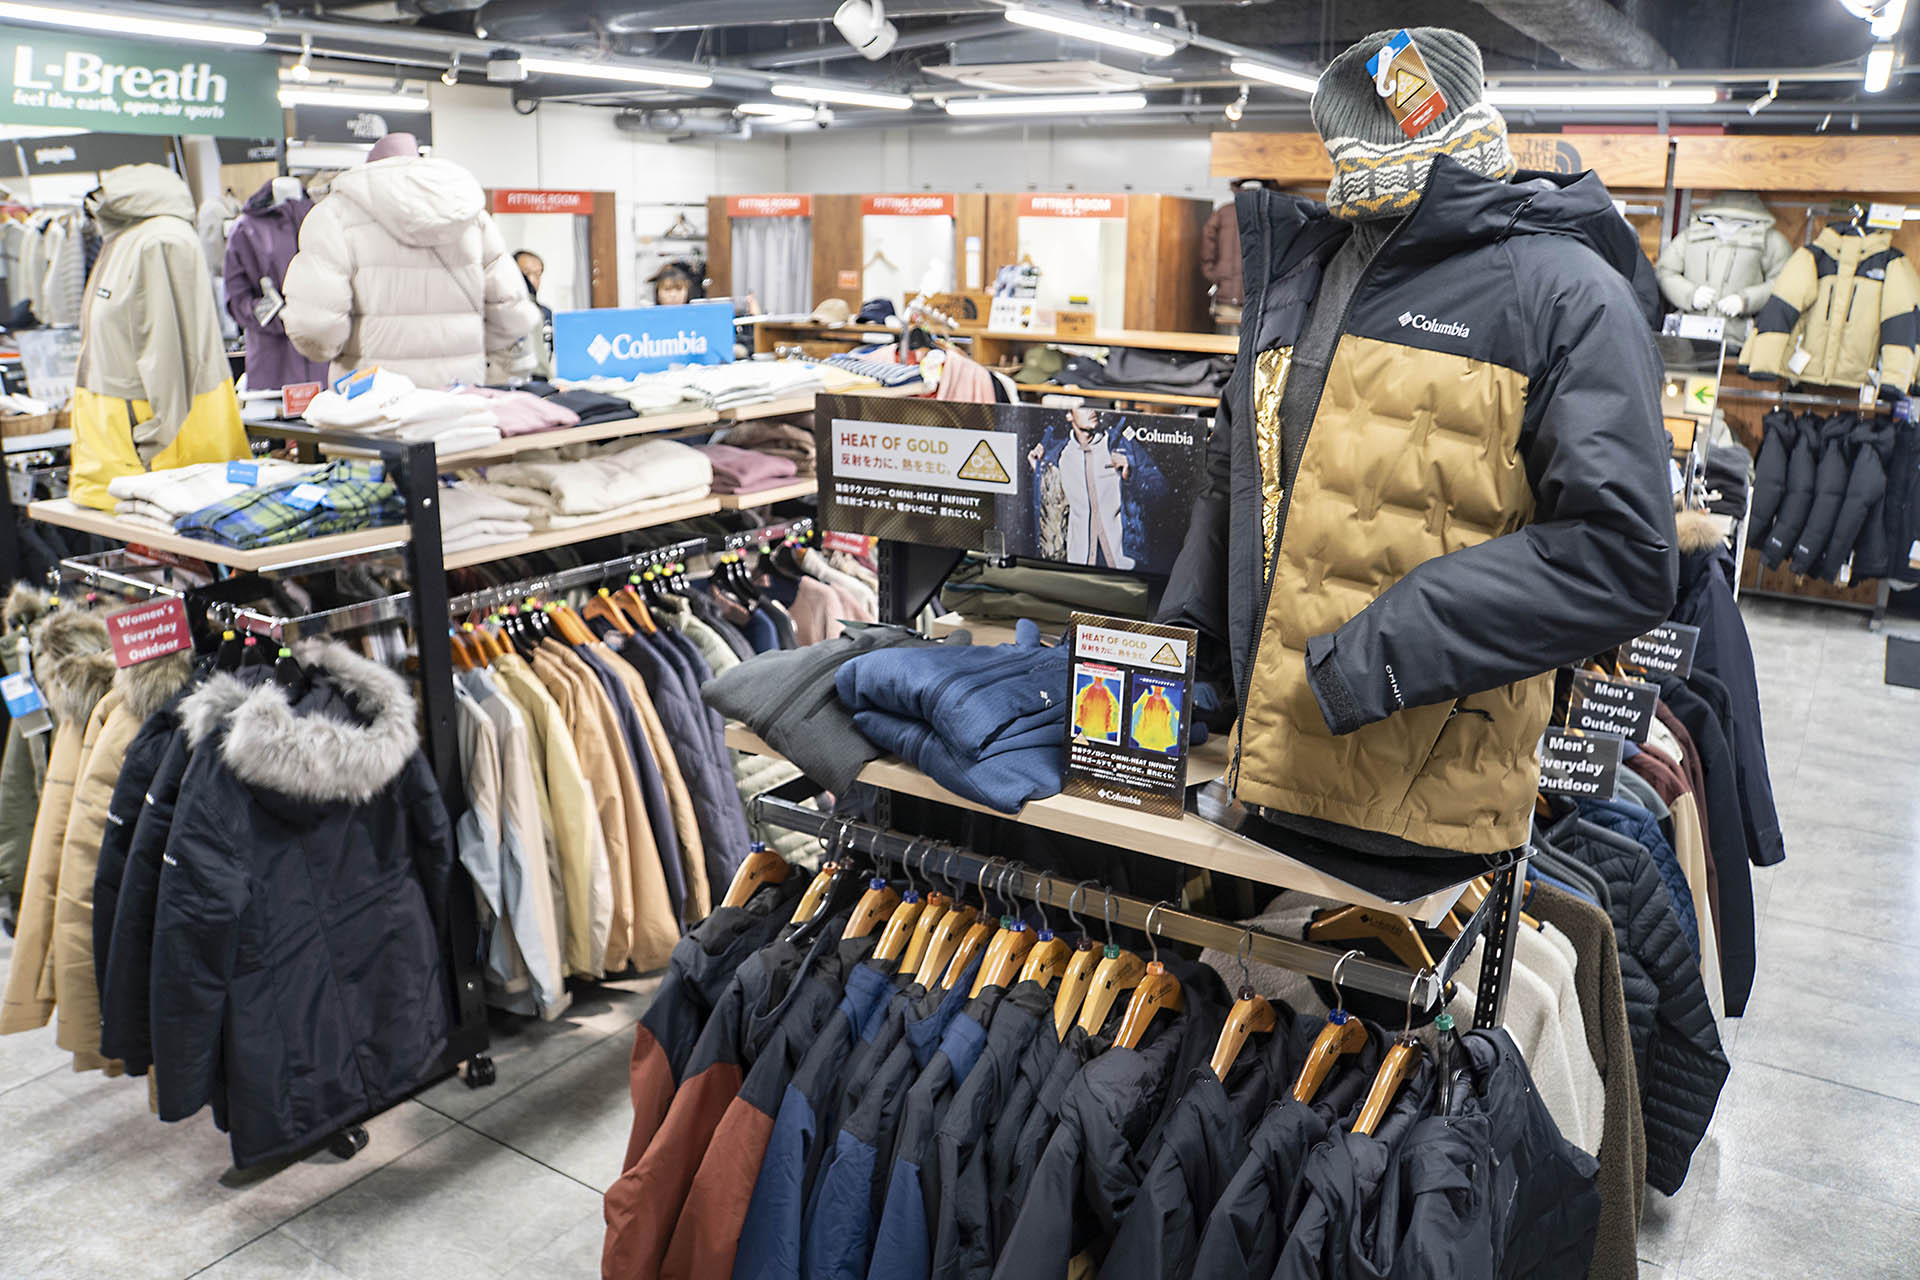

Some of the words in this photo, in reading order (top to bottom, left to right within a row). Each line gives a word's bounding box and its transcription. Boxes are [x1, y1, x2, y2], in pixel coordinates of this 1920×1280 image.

[14, 45, 228, 103] L-Breath
[13, 88, 46, 106] feel
[48, 91, 75, 109] the
[184, 104, 225, 120] sports
[507, 193, 546, 206] FITTING
[548, 194, 580, 207] ROOM
[1411, 314, 1470, 338] Columbia
[611, 330, 708, 360] Columbia
[841, 432, 877, 449] HEAT
[881, 436, 902, 450] OF
[906, 438, 949, 455] GOLD
[1136, 427, 1194, 446] Columbia
[888, 487, 939, 502] OMNI-HEAT
[941, 494, 981, 507] INFINITY
[117, 604, 175, 628] Women's
[122, 622, 177, 645] Everyday
[1081, 632, 1105, 643] HEAT
[1107, 636, 1119, 645] OF
[1122, 638, 1148, 649] GOLD
[129, 639, 179, 662] Outdoor
[1631, 637, 1683, 659] Everyday
[1630, 653, 1678, 672] Outdoor
[1594, 682, 1634, 701] Men's
[1582, 698, 1641, 722] Everyday
[1581, 716, 1636, 738] Outdoor
[1549, 736, 1595, 753] Men's
[1538, 774, 1599, 793] Outdoor
[1106, 790, 1142, 806] Columbia
